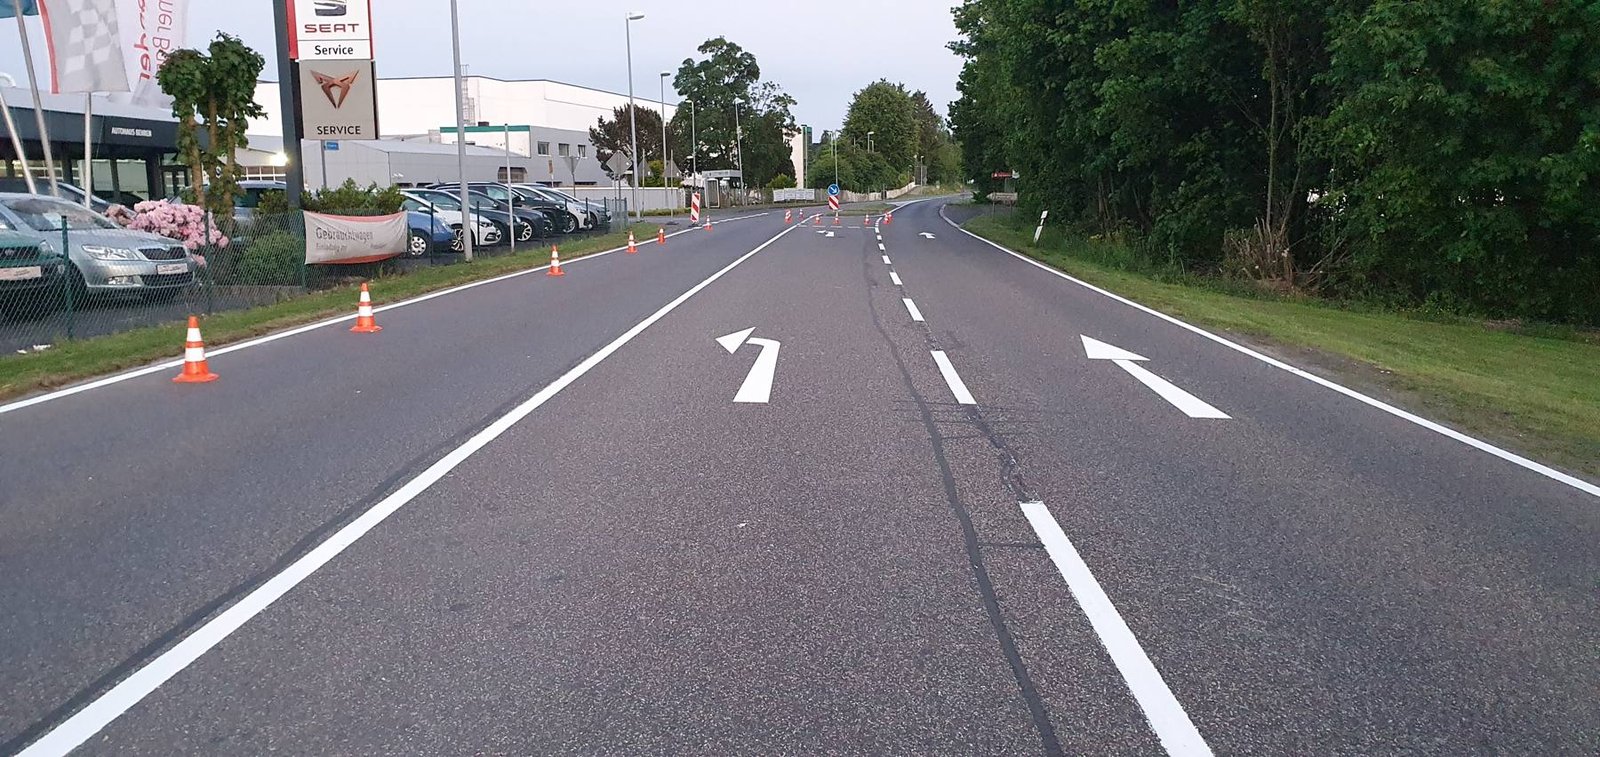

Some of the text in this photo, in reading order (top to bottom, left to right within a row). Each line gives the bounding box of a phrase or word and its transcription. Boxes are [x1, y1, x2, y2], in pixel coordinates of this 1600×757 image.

[304, 23, 360, 33] SEAT
[314, 44, 354, 55] Service
[316, 125, 361, 135] SERVICE
[315, 226, 373, 243] Gebrauchtwagen
